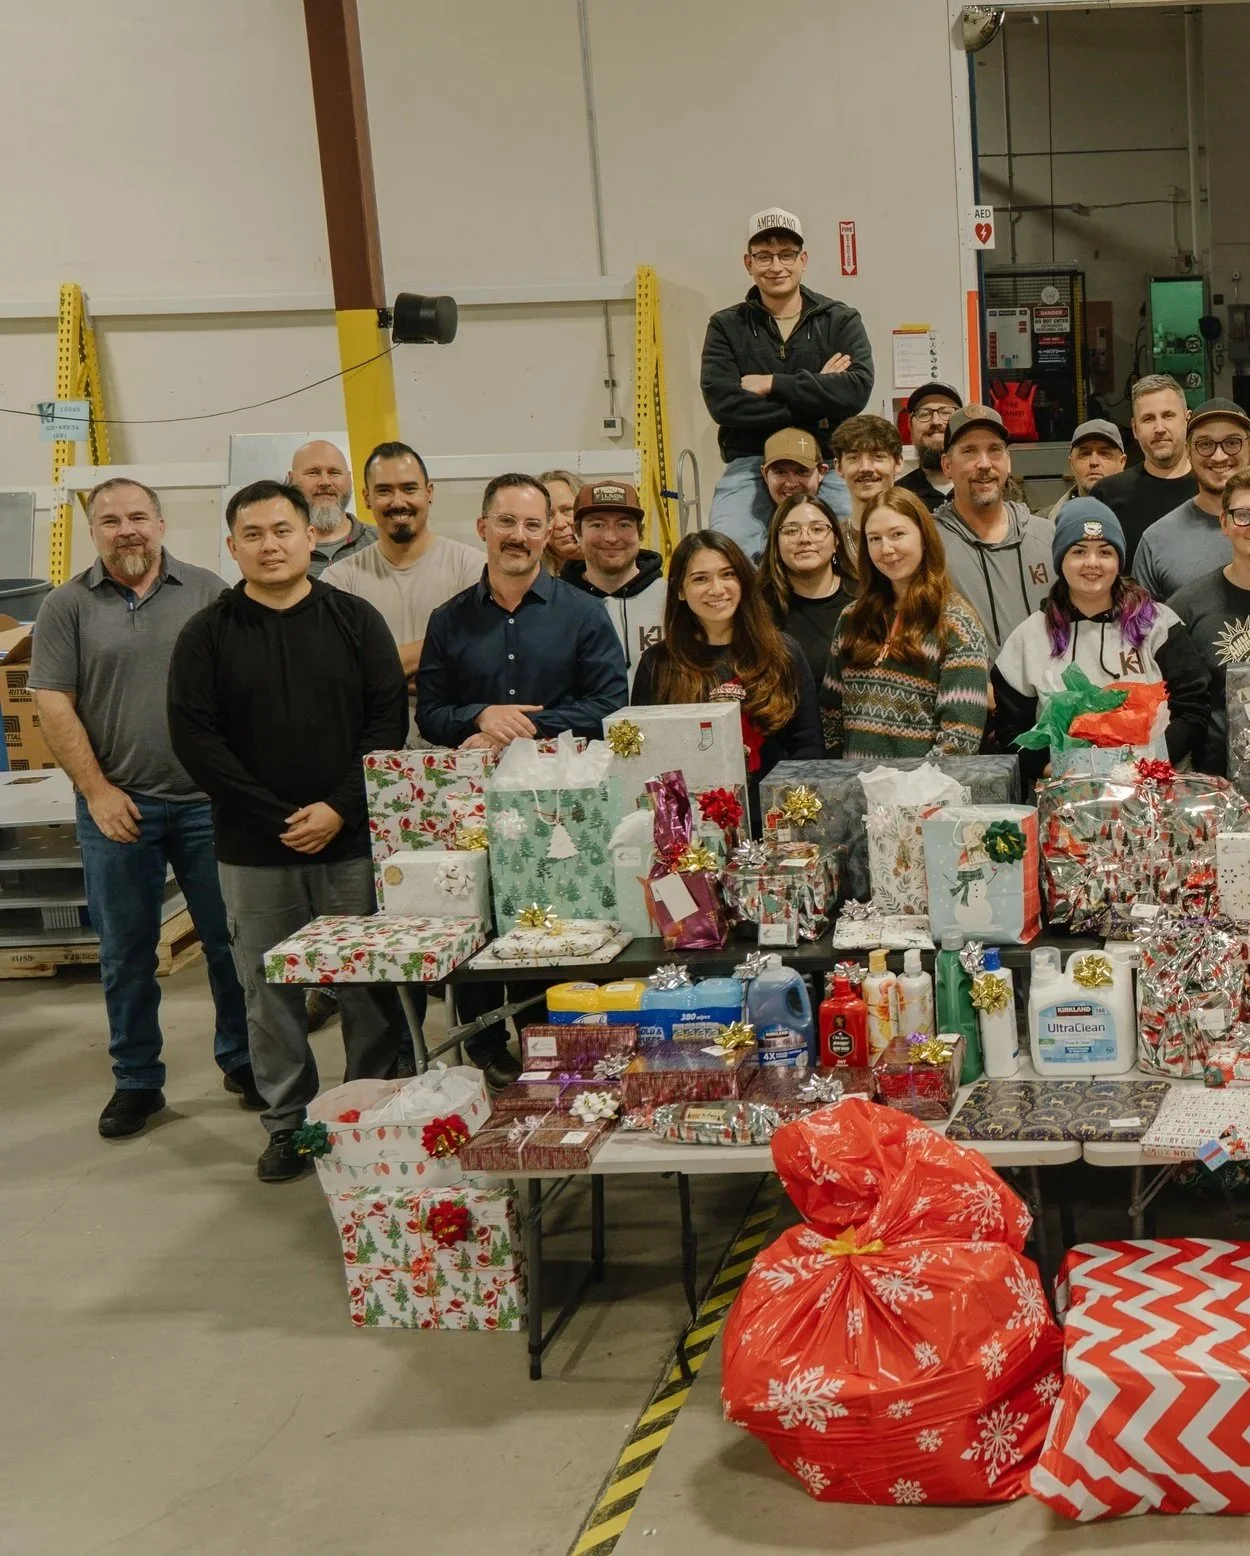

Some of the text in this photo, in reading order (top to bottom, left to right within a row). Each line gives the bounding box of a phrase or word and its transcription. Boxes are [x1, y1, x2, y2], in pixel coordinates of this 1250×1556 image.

[974, 209, 992, 219] AED
[756, 214, 796, 231] AMERICANO
[680, 1013, 696, 1021] 380
[1047, 1023, 1106, 1033] UltraClean
[762, 1052, 776, 1061] 4X
